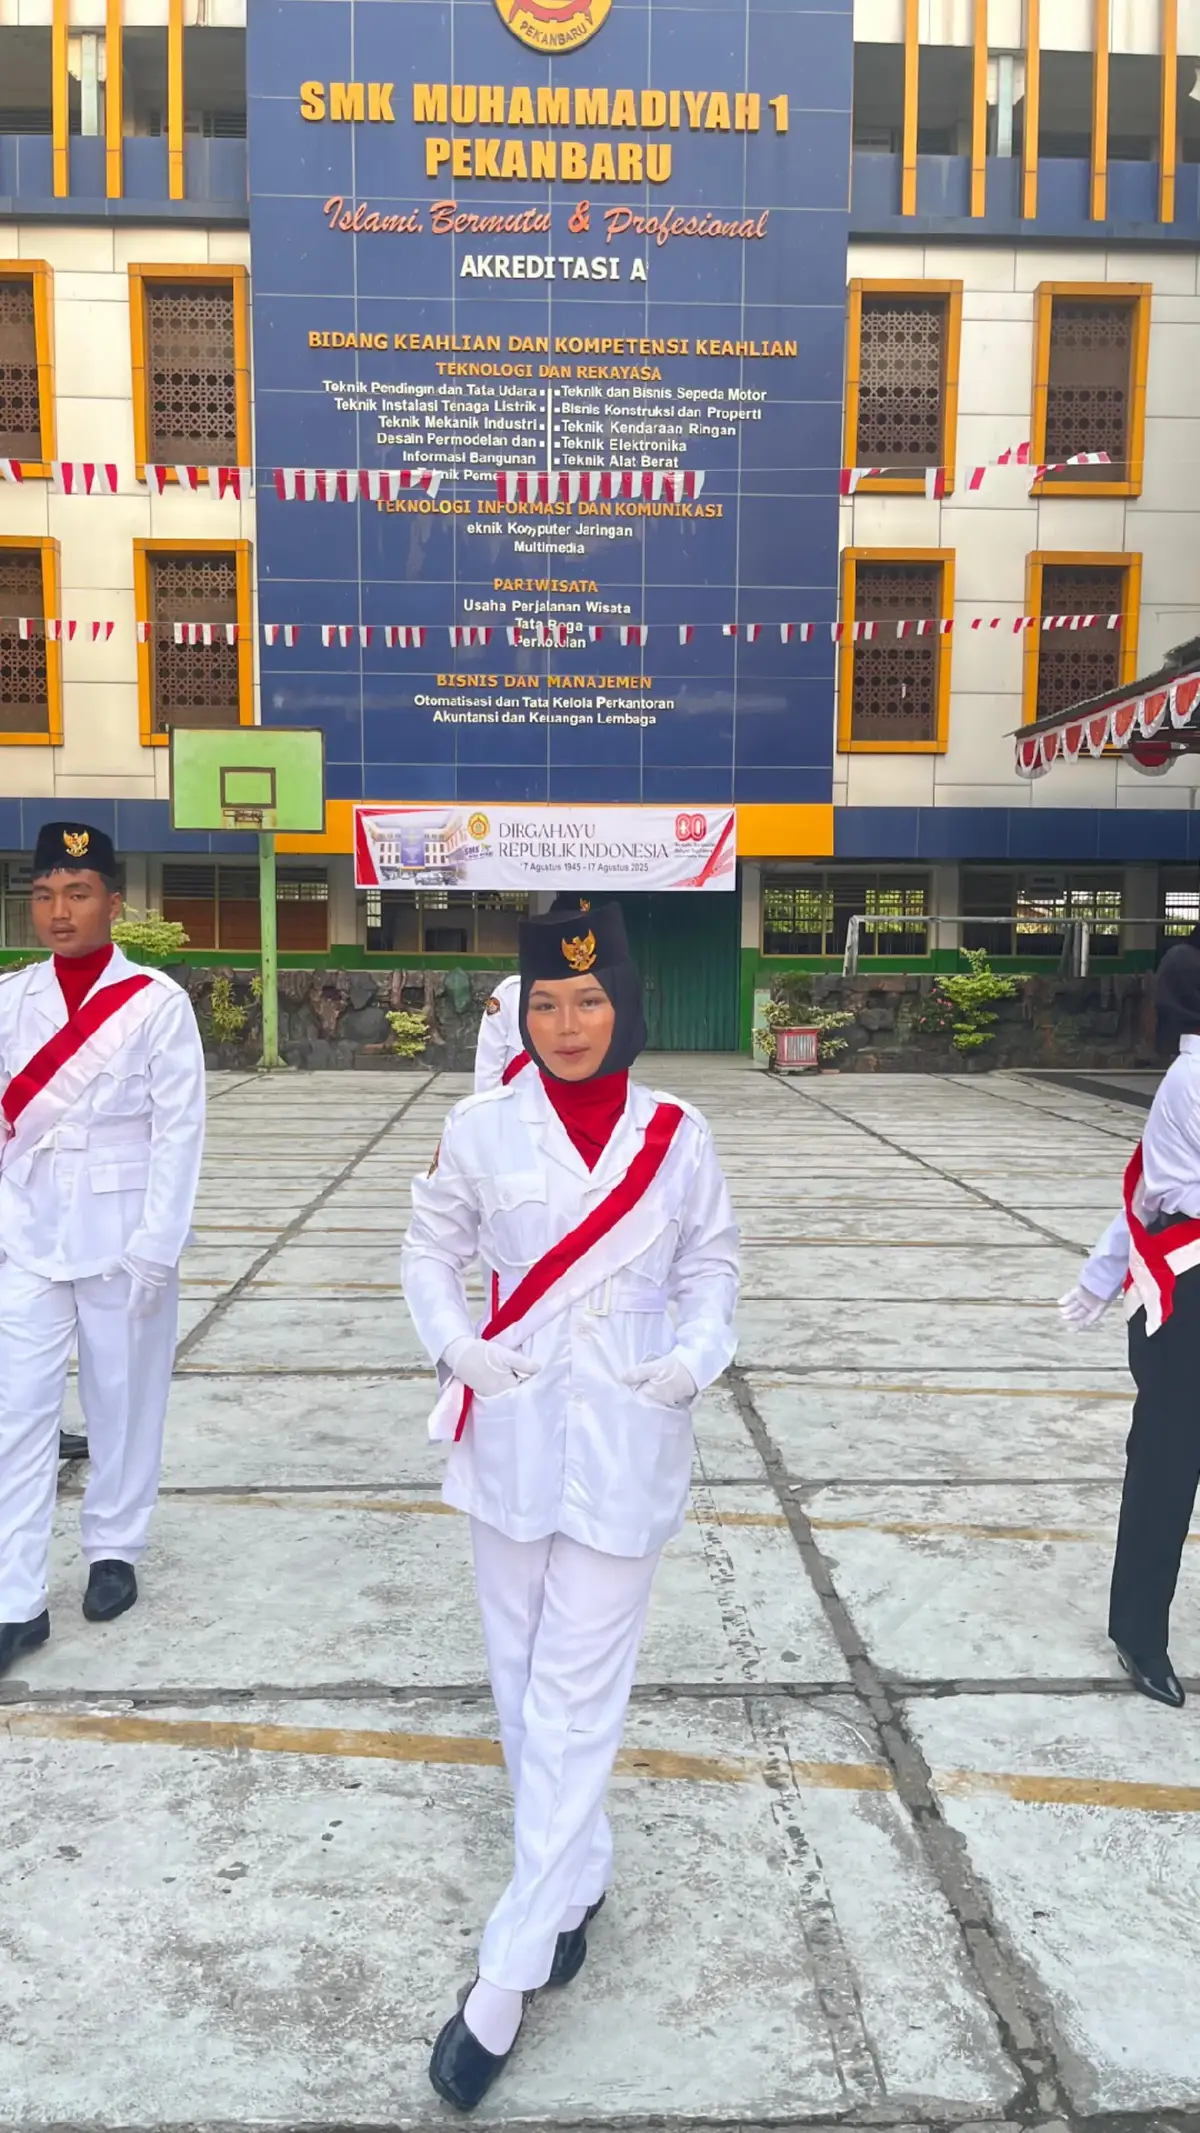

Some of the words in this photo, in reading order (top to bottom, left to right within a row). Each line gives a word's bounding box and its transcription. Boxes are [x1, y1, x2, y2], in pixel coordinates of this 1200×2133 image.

[519, 20, 588, 46] PEKANBARU
[299, 81, 396, 122] SMK
[413, 83, 760, 132] MUHAMMADIYAH
[769, 94, 790, 133] 1
[426, 137, 672, 183] PEKANBARU
[430, 201, 551, 234] Bermutu
[567, 201, 591, 234] &
[603, 207, 768, 244] Profesional
[459, 255, 621, 281] AKREDITASI
[630, 257, 647, 282] A
[308, 331, 389, 351] BIDANG
[394, 334, 502, 352] KEAHLIAN
[508, 336, 550, 353] DAN
[555, 337, 690, 355] KOMPETENSI
[696, 339, 798, 358] KEAHLIAN
[436, 362, 533, 378] TEKNOLOGI
[539, 365, 572, 379] DAN
[576, 366, 663, 381] REKAYASA
[322, 380, 368, 394] Teknik
[371, 381, 435, 398] Pendingin
[438, 384, 463, 396] dan
[466, 384, 496, 397] Tata
[498, 385, 538, 398] Udara
[561, 385, 602, 399] Teknik
[606, 386, 630, 400] dan
[633, 387, 672, 401] Bisnis
[677, 388, 725, 404] Sepeda
[728, 388, 768, 402] Motor
[334, 397, 378, 413] Teknik
[381, 398, 439, 414] Instalasi
[441, 399, 490, 415] Tenaga
[494, 399, 538, 414] Listrik
[561, 403, 600, 416] Bisnis
[604, 404, 675, 418] Konstruksi
[677, 405, 701, 419] dan
[707, 406, 762, 422] Properti
[378, 415, 420, 429] Teknik
[424, 416, 480, 430] Mekanik
[484, 417, 538, 431] Industri
[561, 419, 604, 434] Teknik
[609, 421, 683, 436] Kendaraan
[688, 422, 736, 439] Ringan
[376, 432, 424, 446] Desain
[427, 433, 508, 447] Permodelan
[511, 434, 538, 448] dan
[561, 436, 604, 450] Teknik
[609, 438, 687, 453] Elektronika
[402, 450, 466, 463] Informasi
[469, 451, 537, 466] Bangunan
[562, 453, 604, 467] Teknik
[609, 455, 636, 468] Alat
[641, 456, 679, 469] Berat
[376, 499, 471, 516] TEKNOLOGI
[477, 502, 572, 517] INFORMASI
[578, 502, 612, 517] DAN
[615, 503, 724, 519] KOMUNIKASI
[575, 523, 634, 541] Jaringan
[514, 541, 585, 556] Multimedia
[493, 578, 599, 594] PARIWISATA
[463, 599, 507, 613] Usaha
[511, 600, 581, 617] Perjalanan
[585, 601, 632, 616] Wisata
[436, 674, 498, 690] BISNIS
[504, 676, 539, 691] DAN
[548, 676, 653, 690] MANAJEMEN
[414, 694, 492, 708] Otomatisasi
[495, 696, 520, 709] dan
[523, 697, 549, 710] Tata
[553, 697, 593, 711] Kelola
[596, 697, 675, 711] Perkantoran
[433, 711, 500, 725] Akuntansi
[502, 712, 526, 726] dan
[530, 711, 594, 727] Keuangan
[598, 713, 657, 729] Lembaga
[499, 822, 596, 839] DIRGAHAYU
[499, 842, 576, 858] REPUBLIK
[580, 843, 669, 859] INDONESIA
[530, 862, 561, 873] Agustus
[564, 862, 581, 871] 1945
[599, 863, 628, 873] Agustus
[631, 863, 649, 872] 2025
